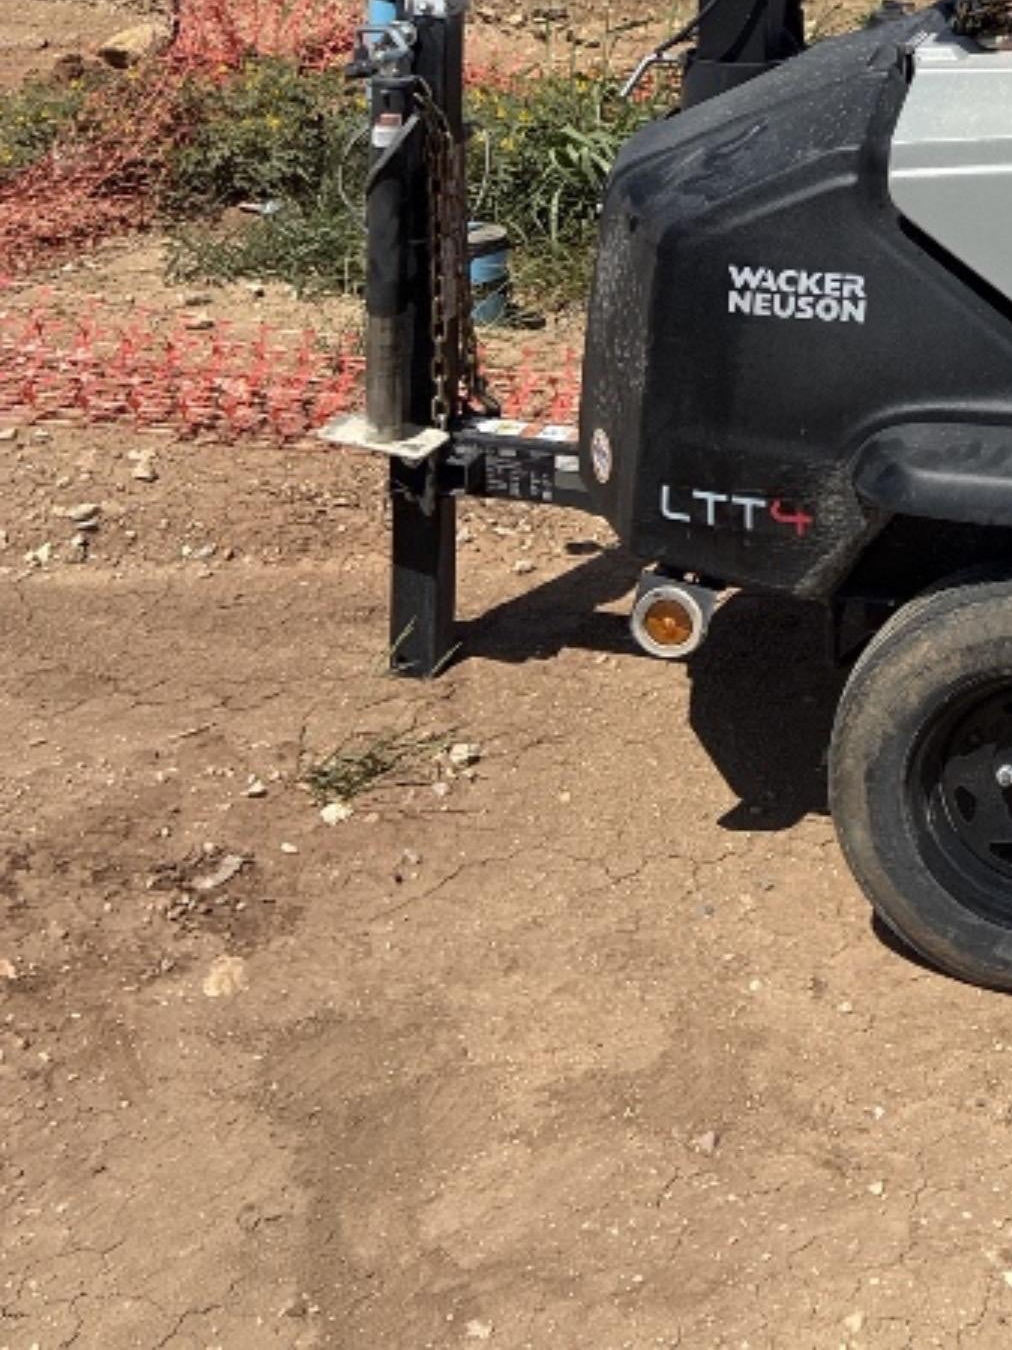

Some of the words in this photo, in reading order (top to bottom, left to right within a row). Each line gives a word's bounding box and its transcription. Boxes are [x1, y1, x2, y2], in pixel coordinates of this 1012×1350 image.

[727, 263, 867, 298] WACKER
[727, 289, 867, 324] NEUSON
[660, 484, 813, 538] LTT4
